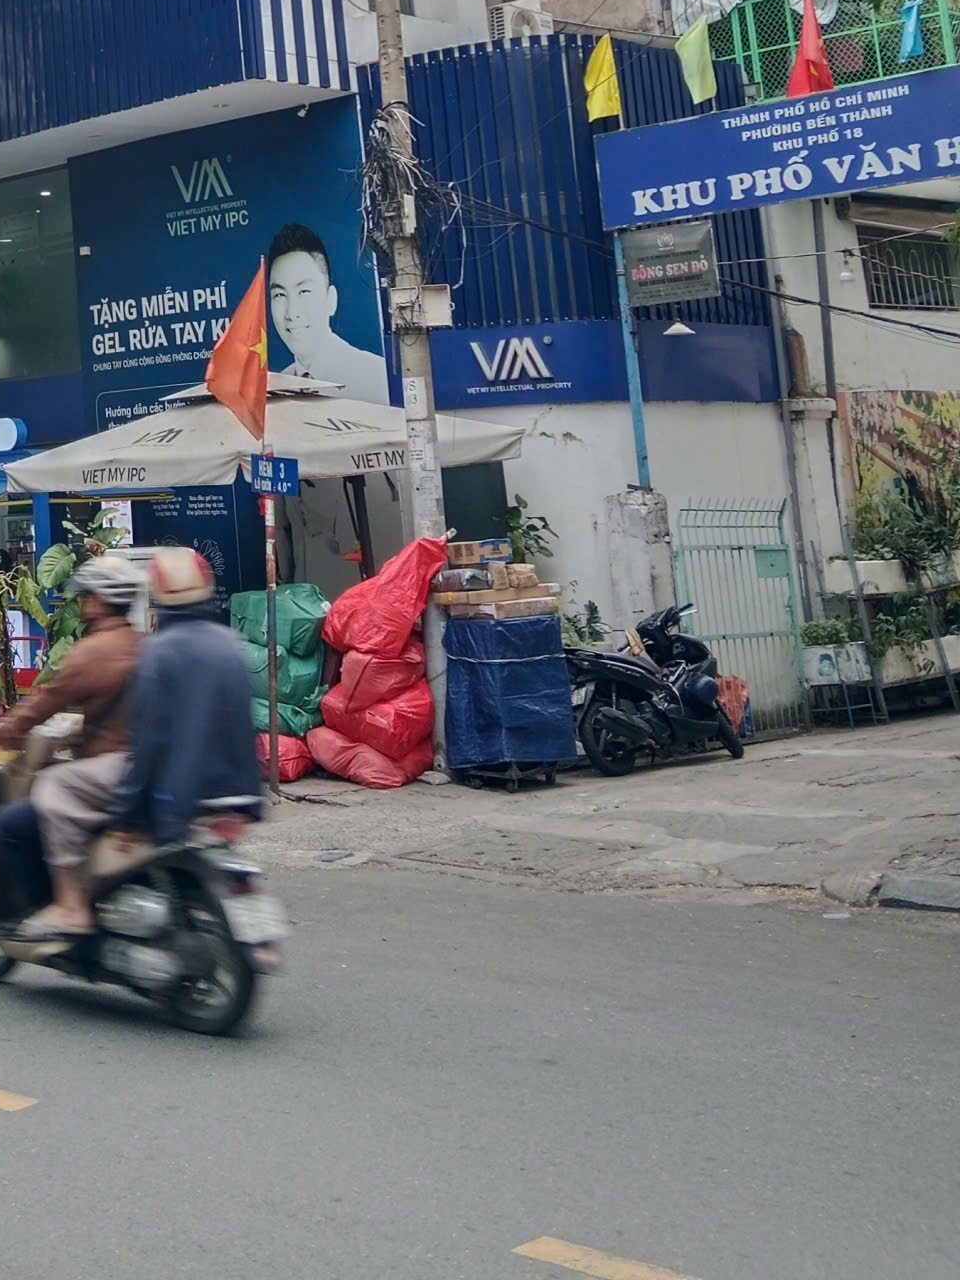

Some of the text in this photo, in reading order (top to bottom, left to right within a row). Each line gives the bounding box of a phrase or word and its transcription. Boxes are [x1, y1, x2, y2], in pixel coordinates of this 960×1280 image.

[722, 112, 770, 129] THÀNH
[774, 101, 805, 119] PHỐ
[835, 90, 863, 108] CHÍ
[867, 85, 910, 102] MINH
[742, 105, 893, 141] PHƯỜNG BẾN THÀNH
[773, 127, 863, 152] KHU PHỐ 18
[632, 178, 716, 216] KHU
[727, 150, 813, 201] PHỐ
[823, 142, 921, 184] VĂN
[167, 210, 249, 237] VIET MY IPC
[90, 280, 227, 328] TẶNG MIỄN PHÍ
[92, 332, 125, 355] GEL
[129, 320, 168, 351] RỬA
[171, 321, 206, 345] TAY
[93, 362, 111, 372] CHUNG
[112, 360, 123, 369] TAY
[490, 384, 534, 393] INTELLECTUAL
[536, 382, 572, 390] PROPERTY
[279, 462, 285, 479] 3
[351, 450, 405, 469] VIET MY
[82, 467, 146, 484] VIET MY IPC
[193, 538, 198, 547] 6
